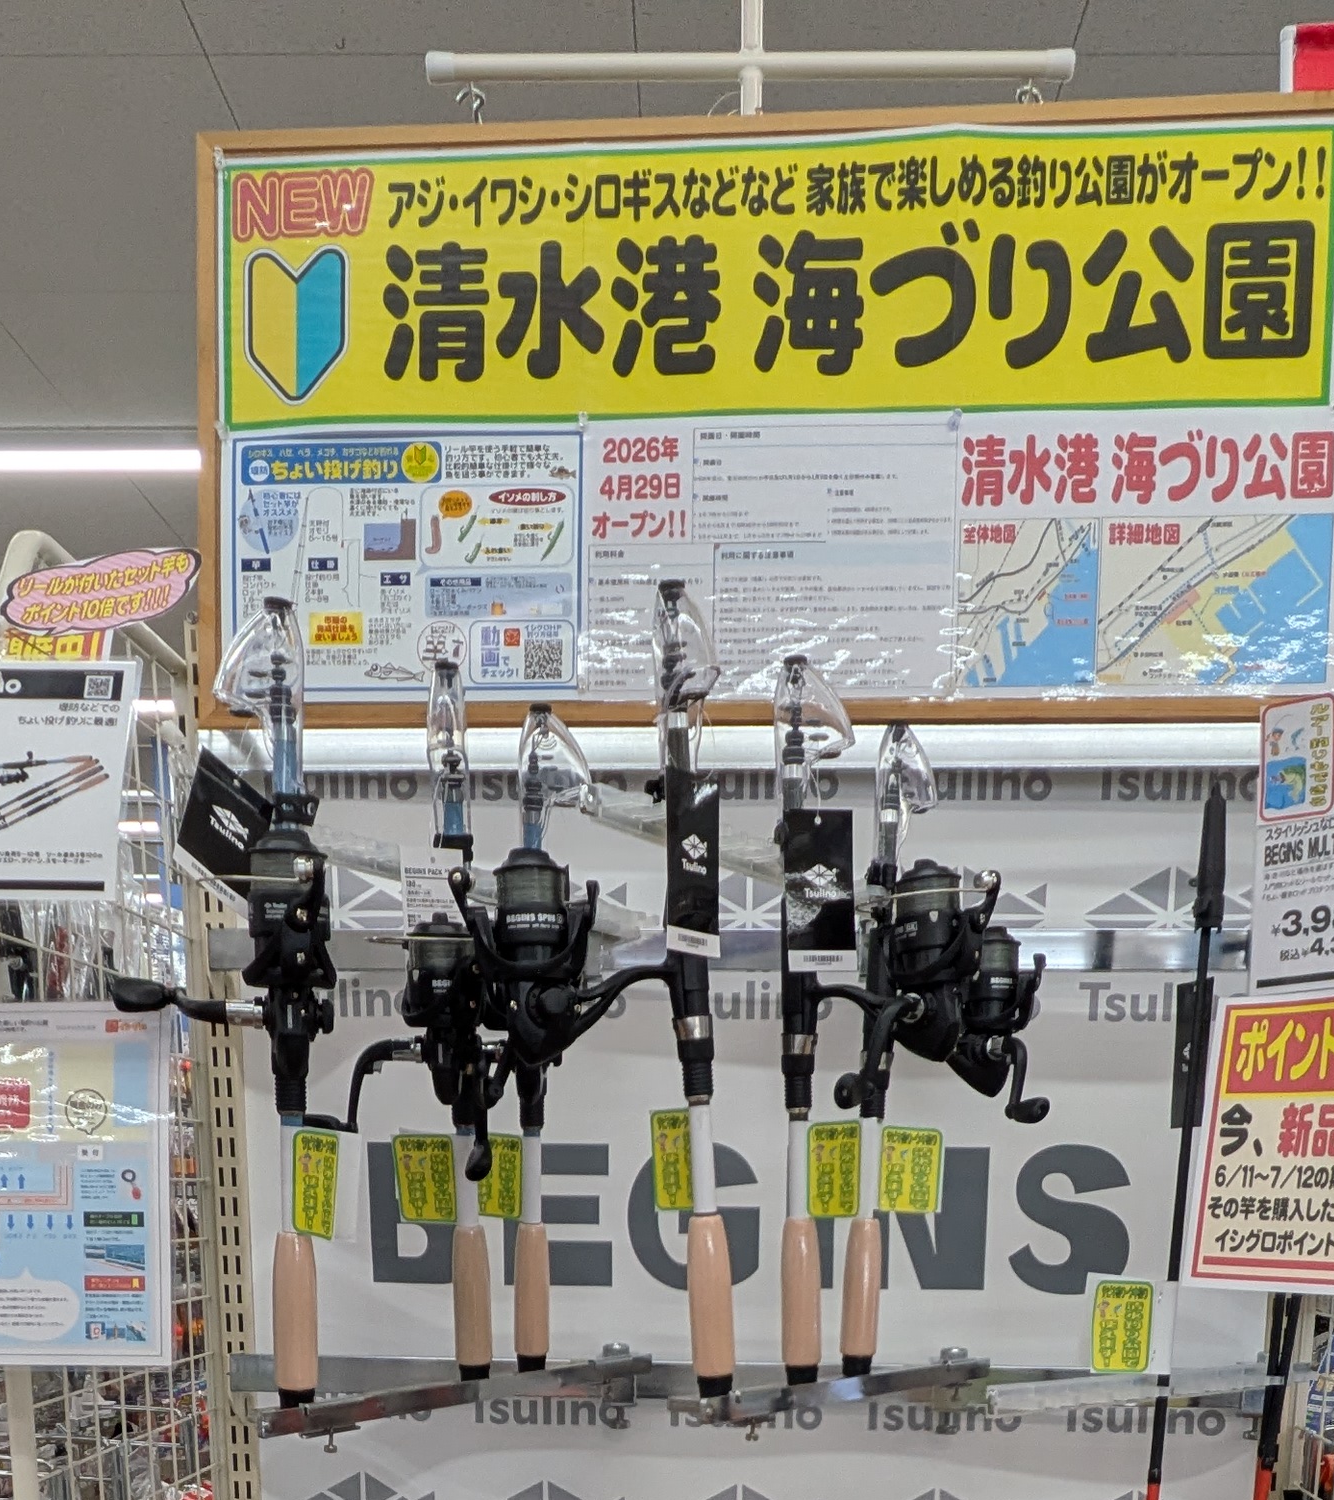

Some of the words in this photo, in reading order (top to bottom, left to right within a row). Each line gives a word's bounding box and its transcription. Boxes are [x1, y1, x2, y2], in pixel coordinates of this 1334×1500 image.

[231, 170, 374, 239] NEW
[384, 234, 724, 381] 清水港
[755, 218, 1316, 376] 海づり公園
[603, 436, 679, 463] 2026年
[271, 460, 398, 481] ちょい投げ釣り
[962, 434, 1100, 505] 清水港
[1111, 432, 1334, 502] 海づり公園
[600, 473, 681, 501] 4月29日
[592, 510, 686, 539] オープン!!
[1109, 523, 1181, 545] 詳細地図
[1264, 841, 1304, 867] BEGINS
